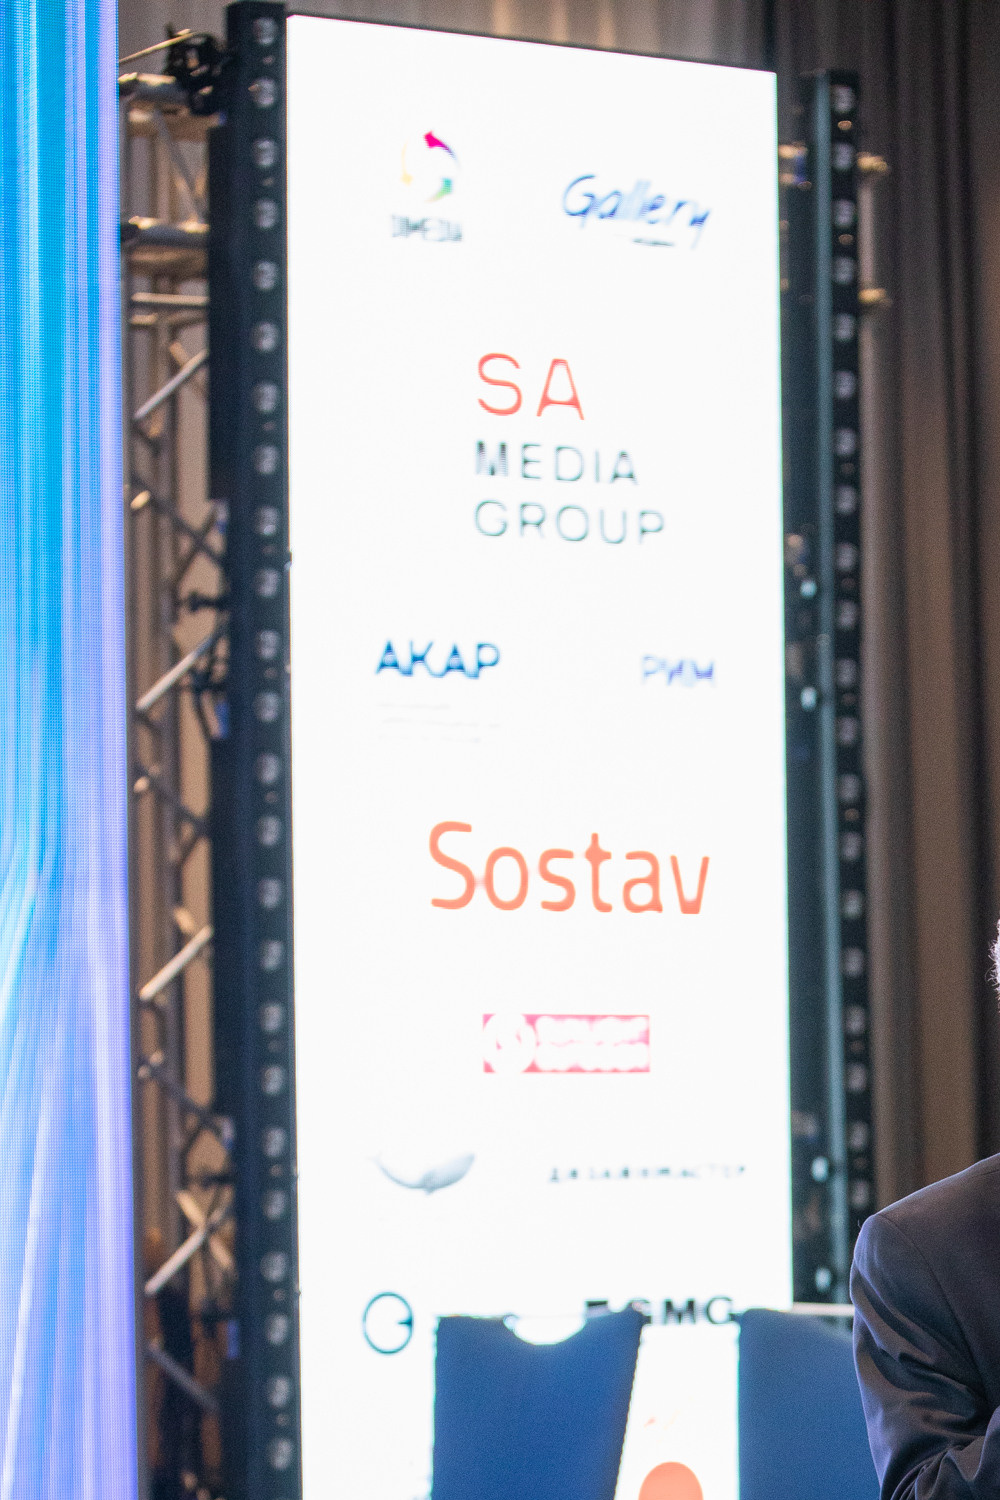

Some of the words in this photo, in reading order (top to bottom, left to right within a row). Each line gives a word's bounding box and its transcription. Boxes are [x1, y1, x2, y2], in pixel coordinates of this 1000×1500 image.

[562, 173, 711, 249] Gallery
[477, 353, 585, 421] SA
[475, 440, 638, 486] MEDIA
[474, 500, 665, 545] GROUP
[429, 820, 710, 915] Sostav
